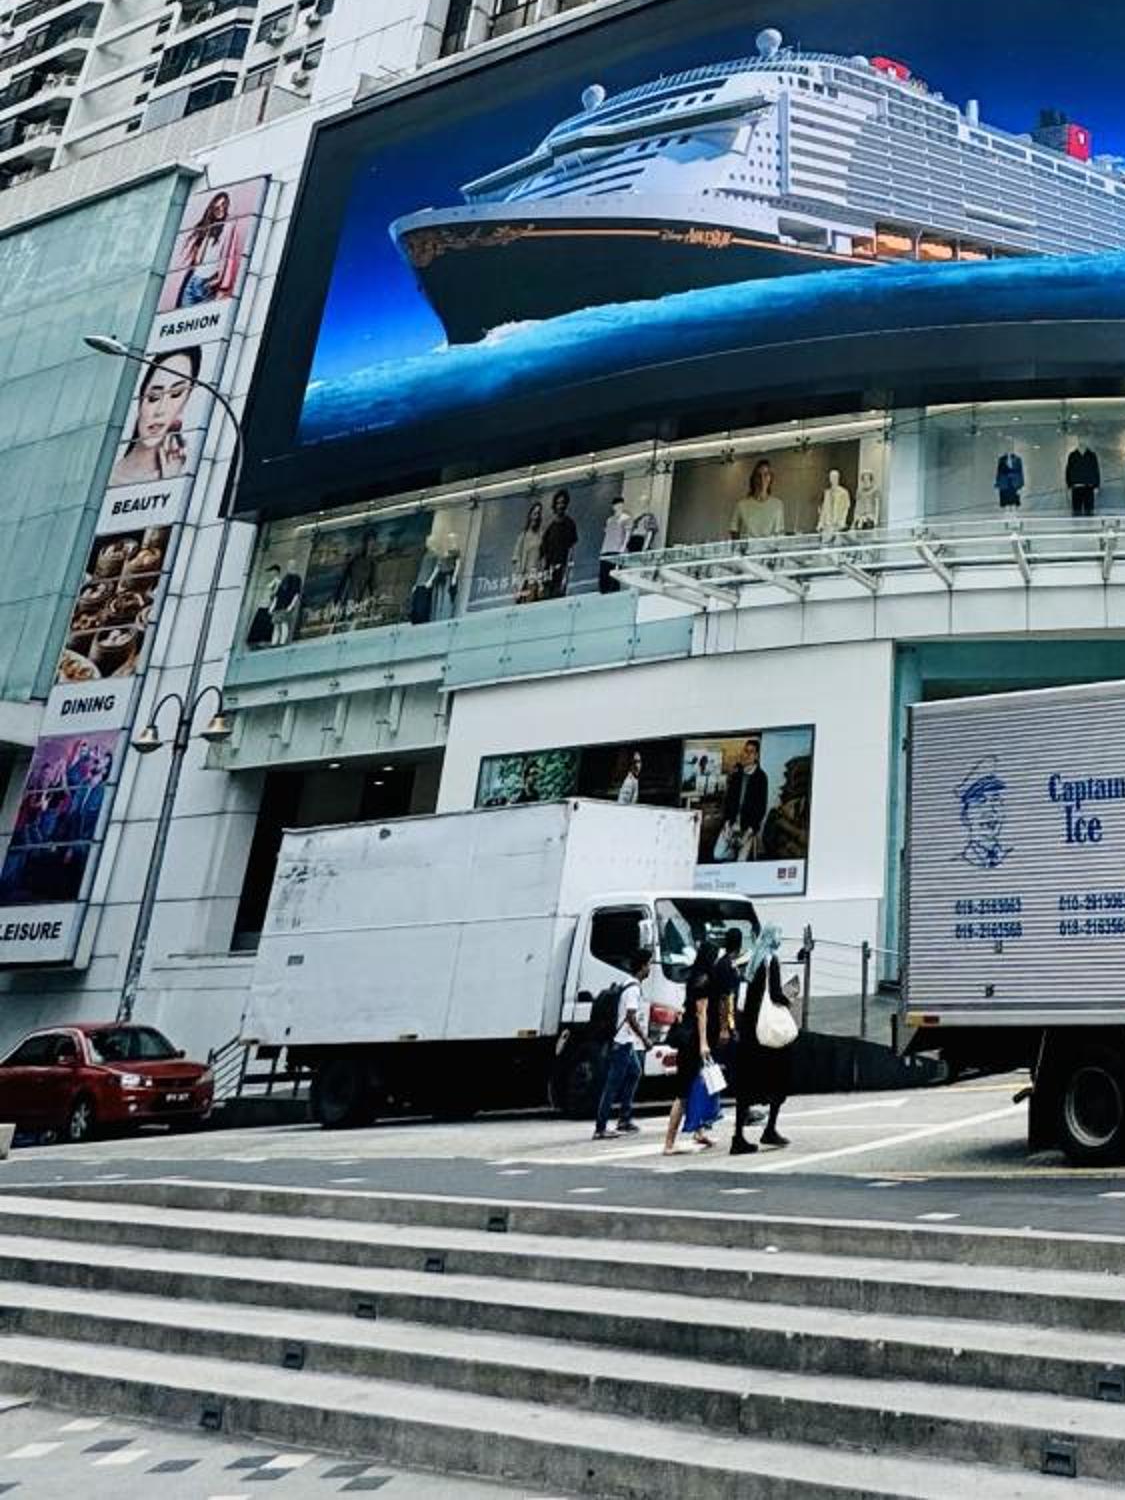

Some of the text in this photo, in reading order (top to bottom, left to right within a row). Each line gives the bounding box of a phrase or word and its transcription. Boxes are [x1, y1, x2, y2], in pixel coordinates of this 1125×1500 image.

[158, 312, 221, 339] FASHION
[111, 491, 172, 517] BEAUTY
[60, 693, 116, 717] DINING
[1065, 804, 1104, 843] Ice
